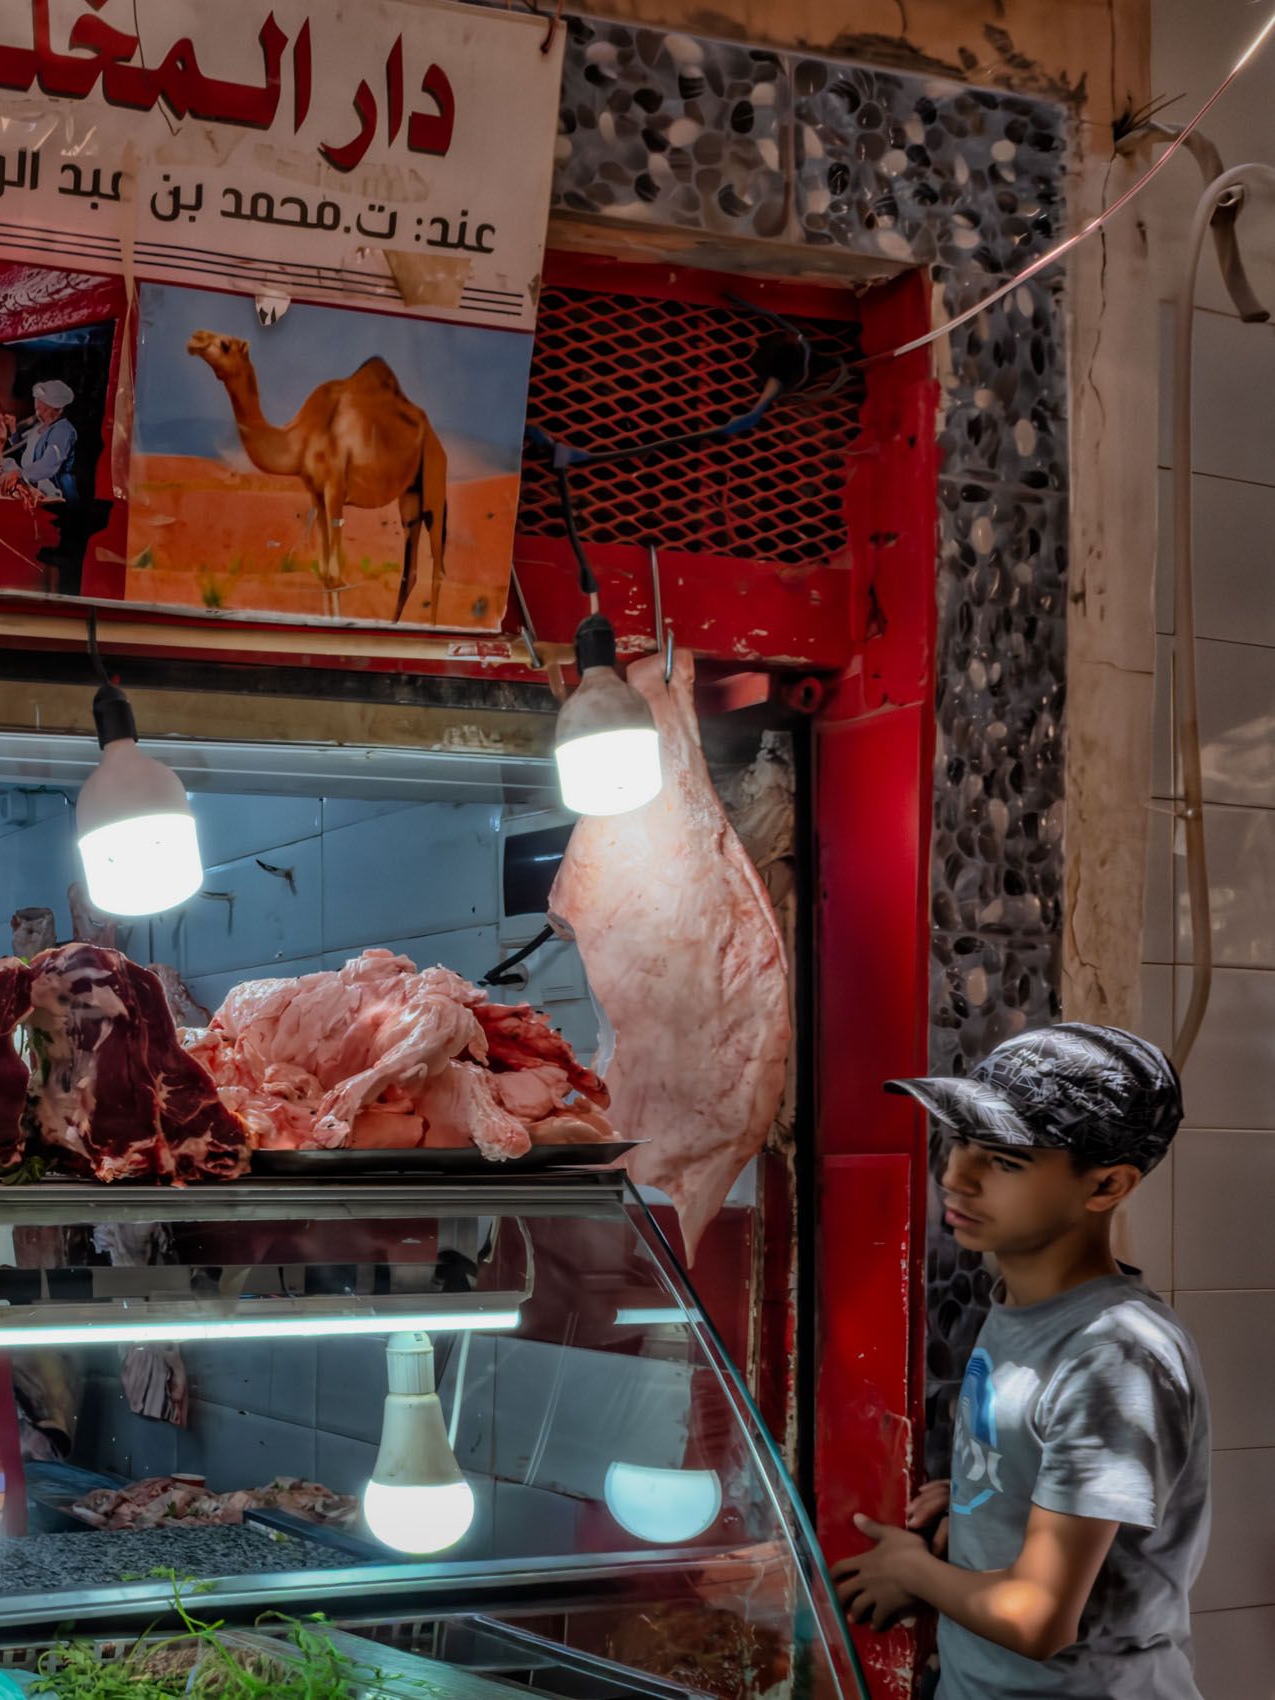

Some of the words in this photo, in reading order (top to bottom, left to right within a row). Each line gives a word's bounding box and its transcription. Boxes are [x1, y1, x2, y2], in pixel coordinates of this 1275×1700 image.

[317, 31, 456, 173] دار
[57, 162, 124, 210] عبد
[149, 173, 204, 222] بن
